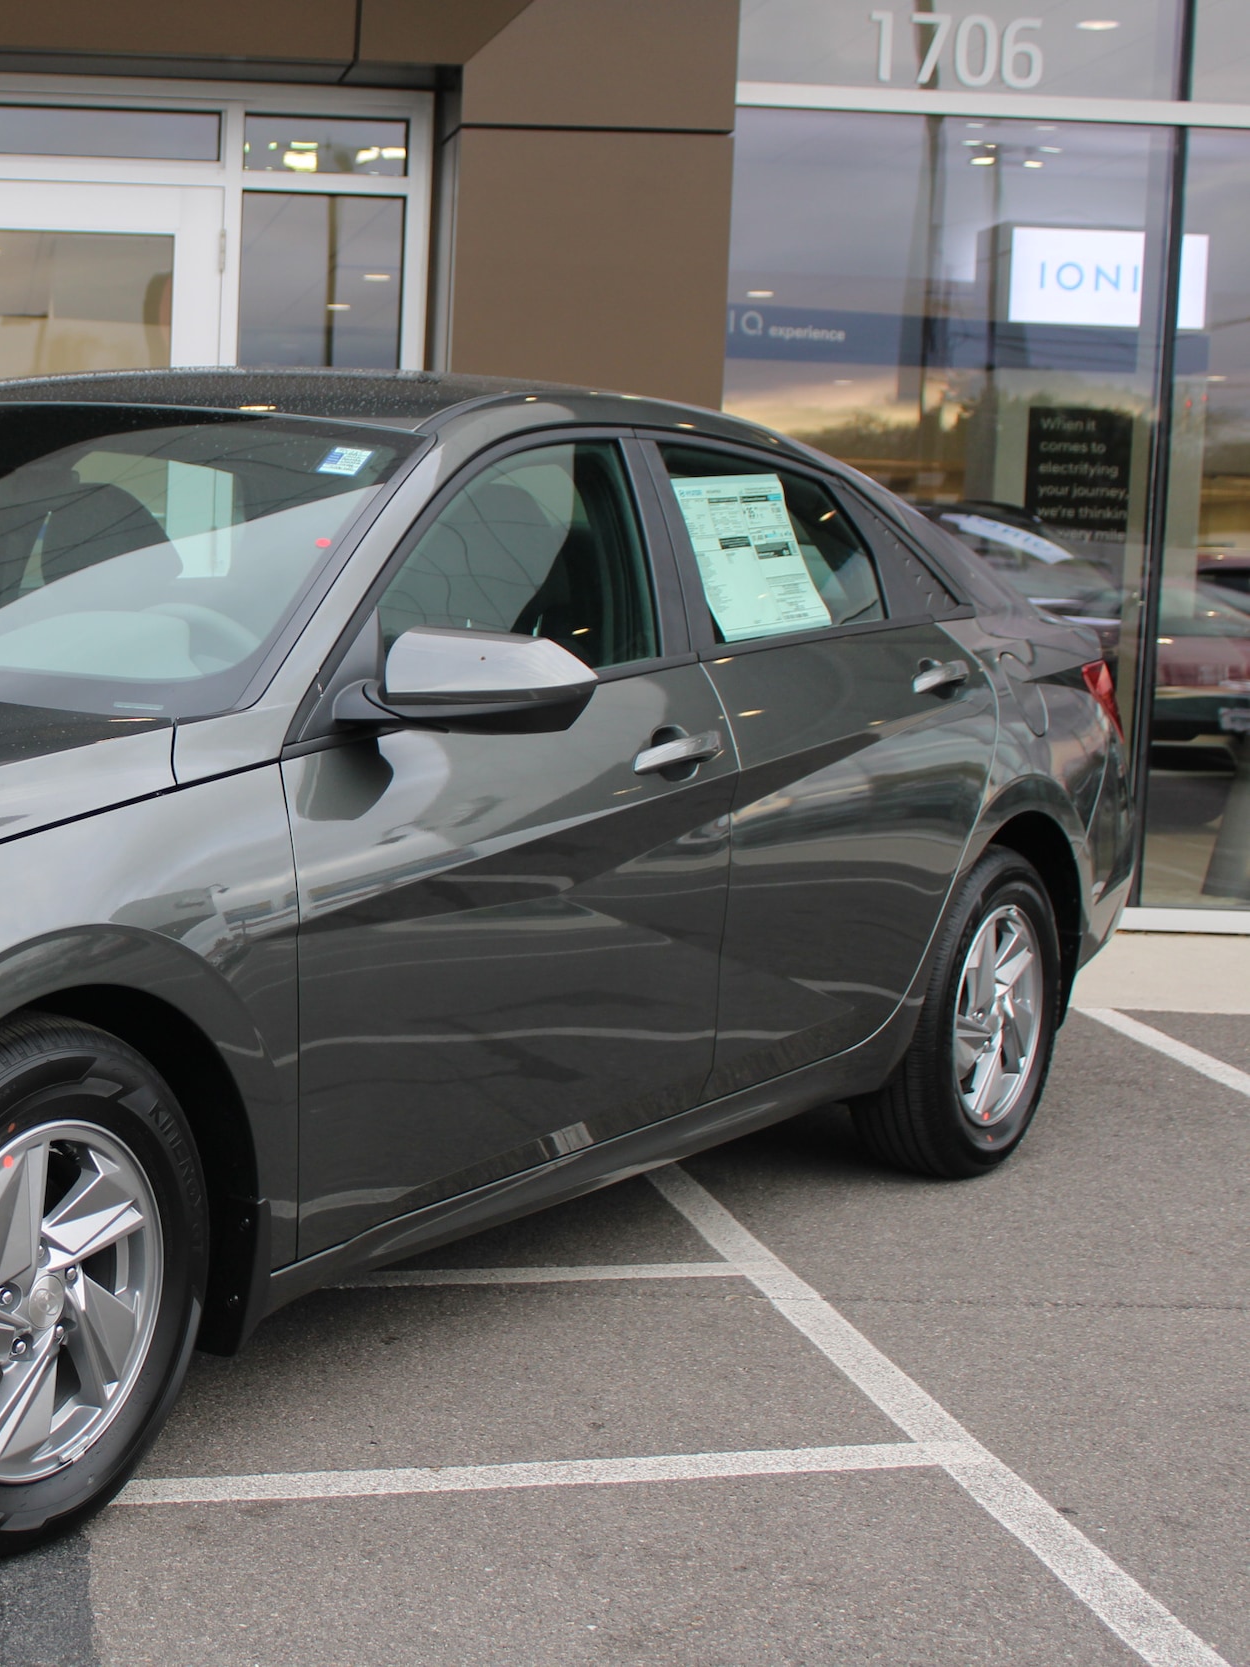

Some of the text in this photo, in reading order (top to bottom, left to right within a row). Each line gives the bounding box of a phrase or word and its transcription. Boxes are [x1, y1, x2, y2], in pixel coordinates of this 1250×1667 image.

[870, 10, 1044, 89] 1706
[768, 325, 847, 343] experience
[1040, 417, 1097, 432] When it
[1039, 441, 1107, 454] comes to
[1038, 462, 1119, 479] electrifying
[1037, 484, 1070, 498] your
[1036, 505, 1076, 518] we're
